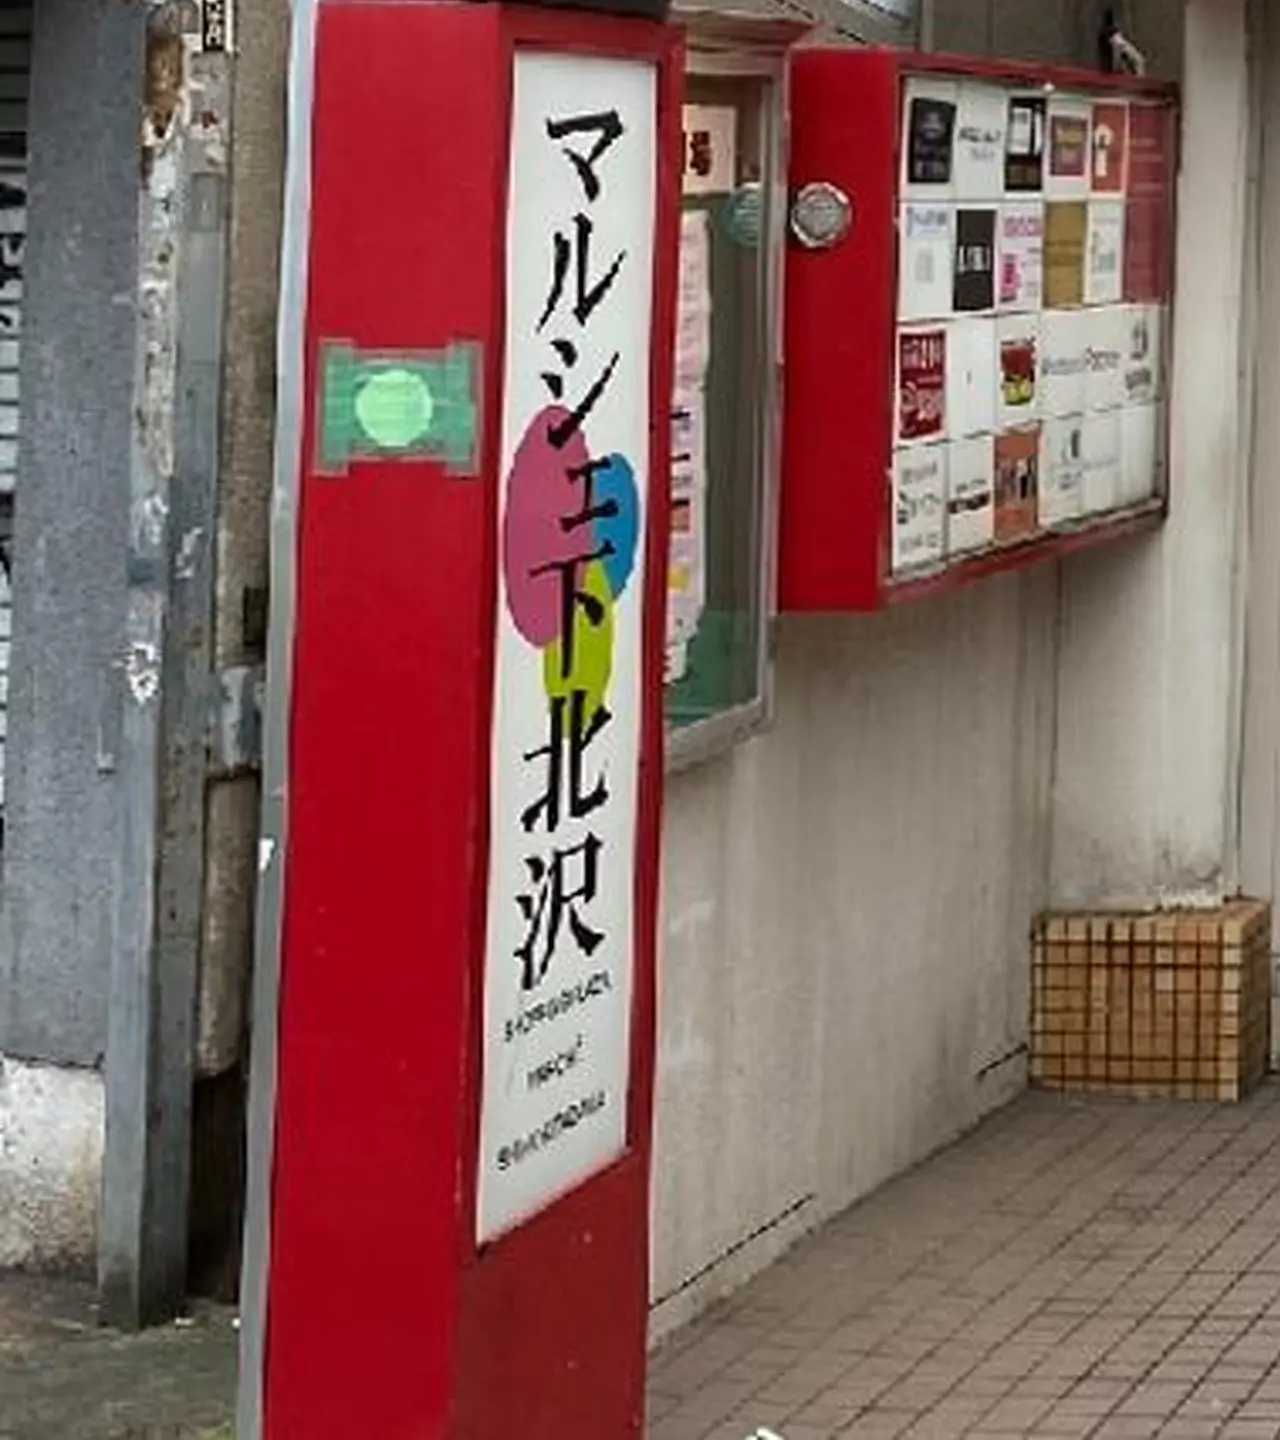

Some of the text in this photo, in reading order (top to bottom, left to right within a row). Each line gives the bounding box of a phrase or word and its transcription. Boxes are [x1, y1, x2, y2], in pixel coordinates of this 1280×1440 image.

[515, 109, 627, 992] マルシェ下北沢
